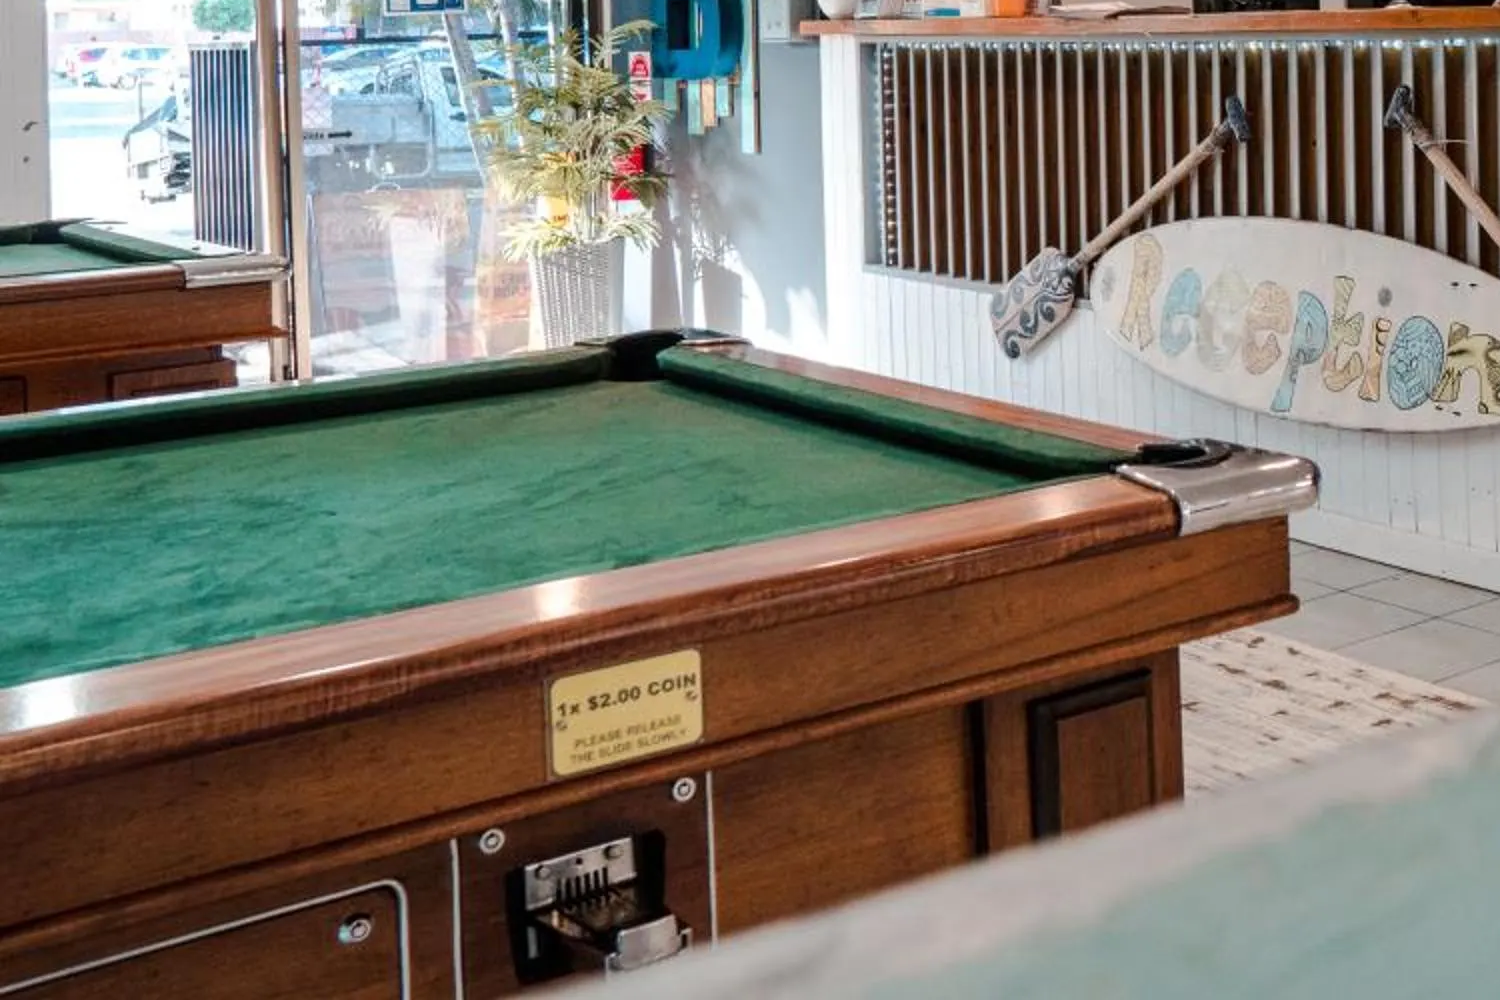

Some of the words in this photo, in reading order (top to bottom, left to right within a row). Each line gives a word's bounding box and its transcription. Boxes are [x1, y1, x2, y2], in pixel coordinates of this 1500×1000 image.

[556, 702, 581, 718] 1x
[587, 685, 642, 712] $2.00
[647, 672, 698, 697] COIN
[570, 750, 593, 764] THE
[598, 741, 632, 759] SLIDE
[636, 728, 687, 748] SLOWLY
[575, 728, 621, 748] PLEASE
[626, 714, 682, 735] RELEASE
